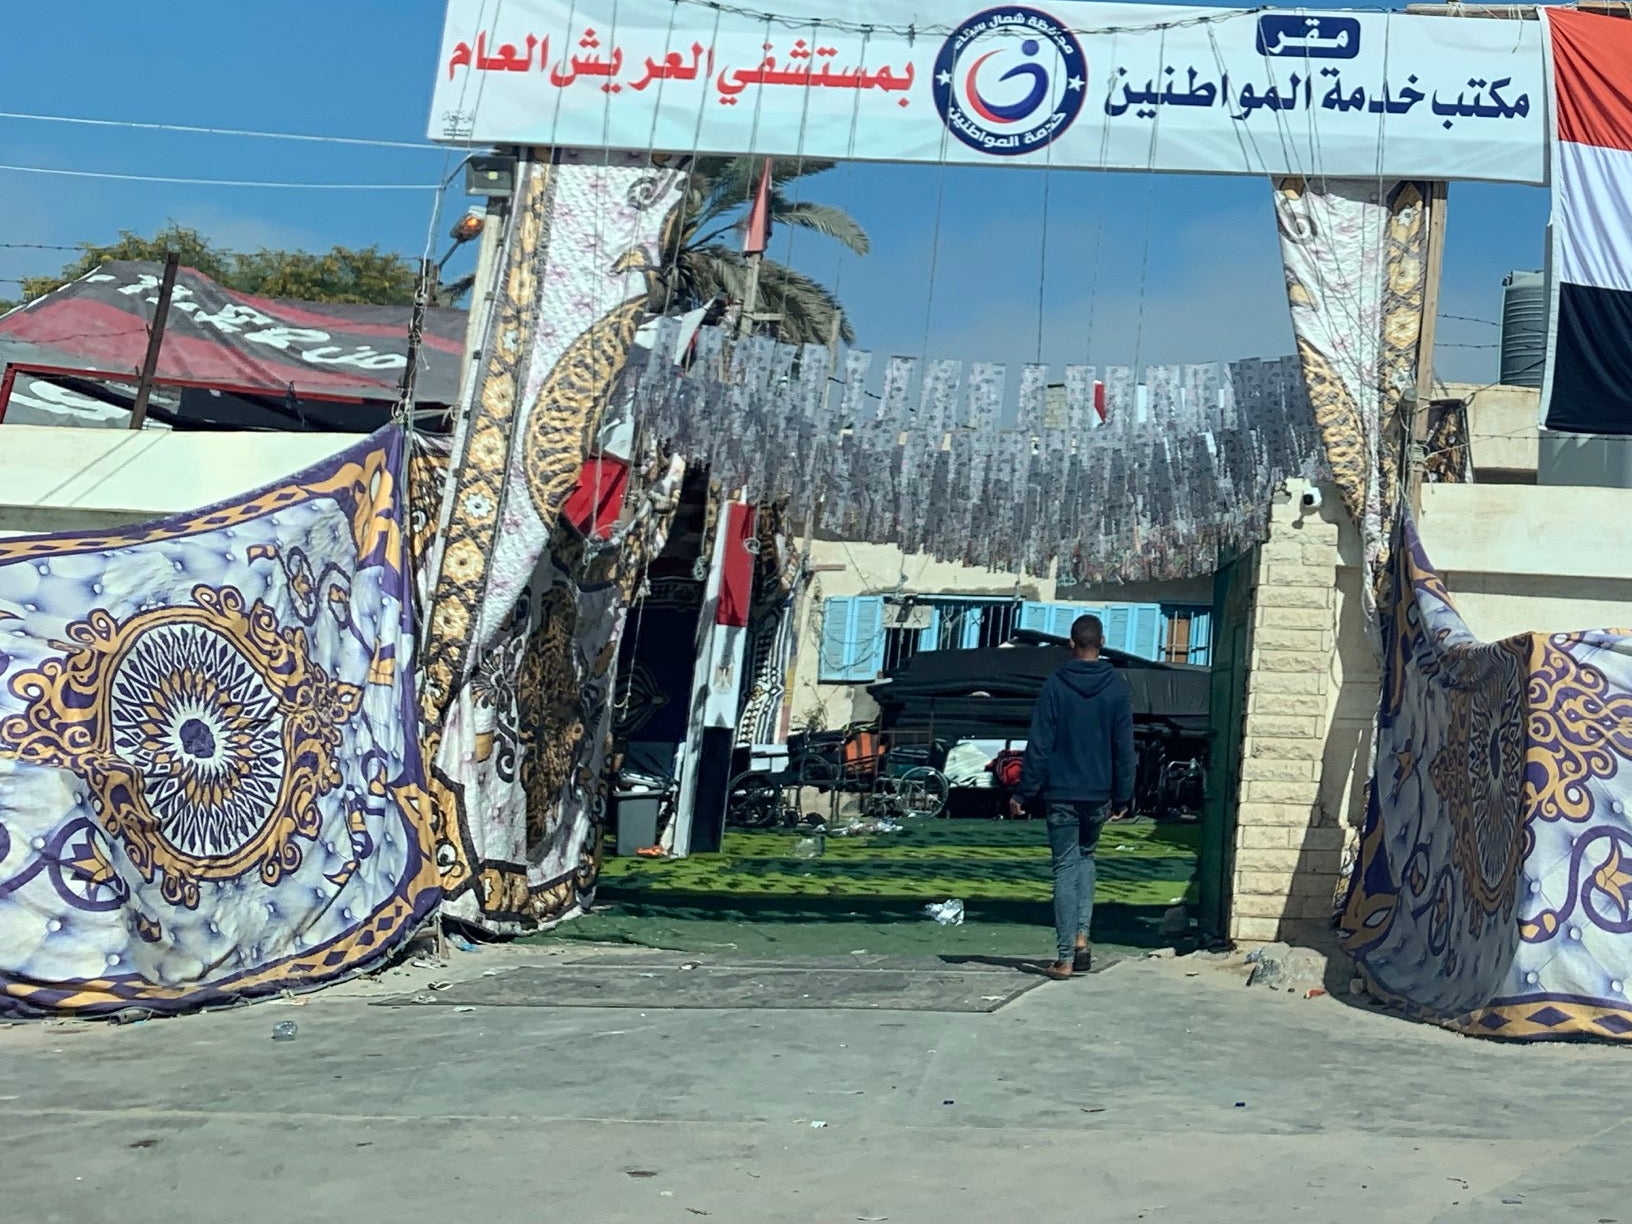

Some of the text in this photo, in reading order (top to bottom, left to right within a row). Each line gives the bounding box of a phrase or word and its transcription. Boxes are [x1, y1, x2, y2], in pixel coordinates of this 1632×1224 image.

[989, 12, 1026, 28] شمال
[1267, 17, 1349, 55] مقر
[448, 28, 915, 108] بمستشفي العريش العام
[1103, 65, 1531, 130] مكتب خدمة المواطنين
[949, 106, 1067, 148] خدمة المواطنين
